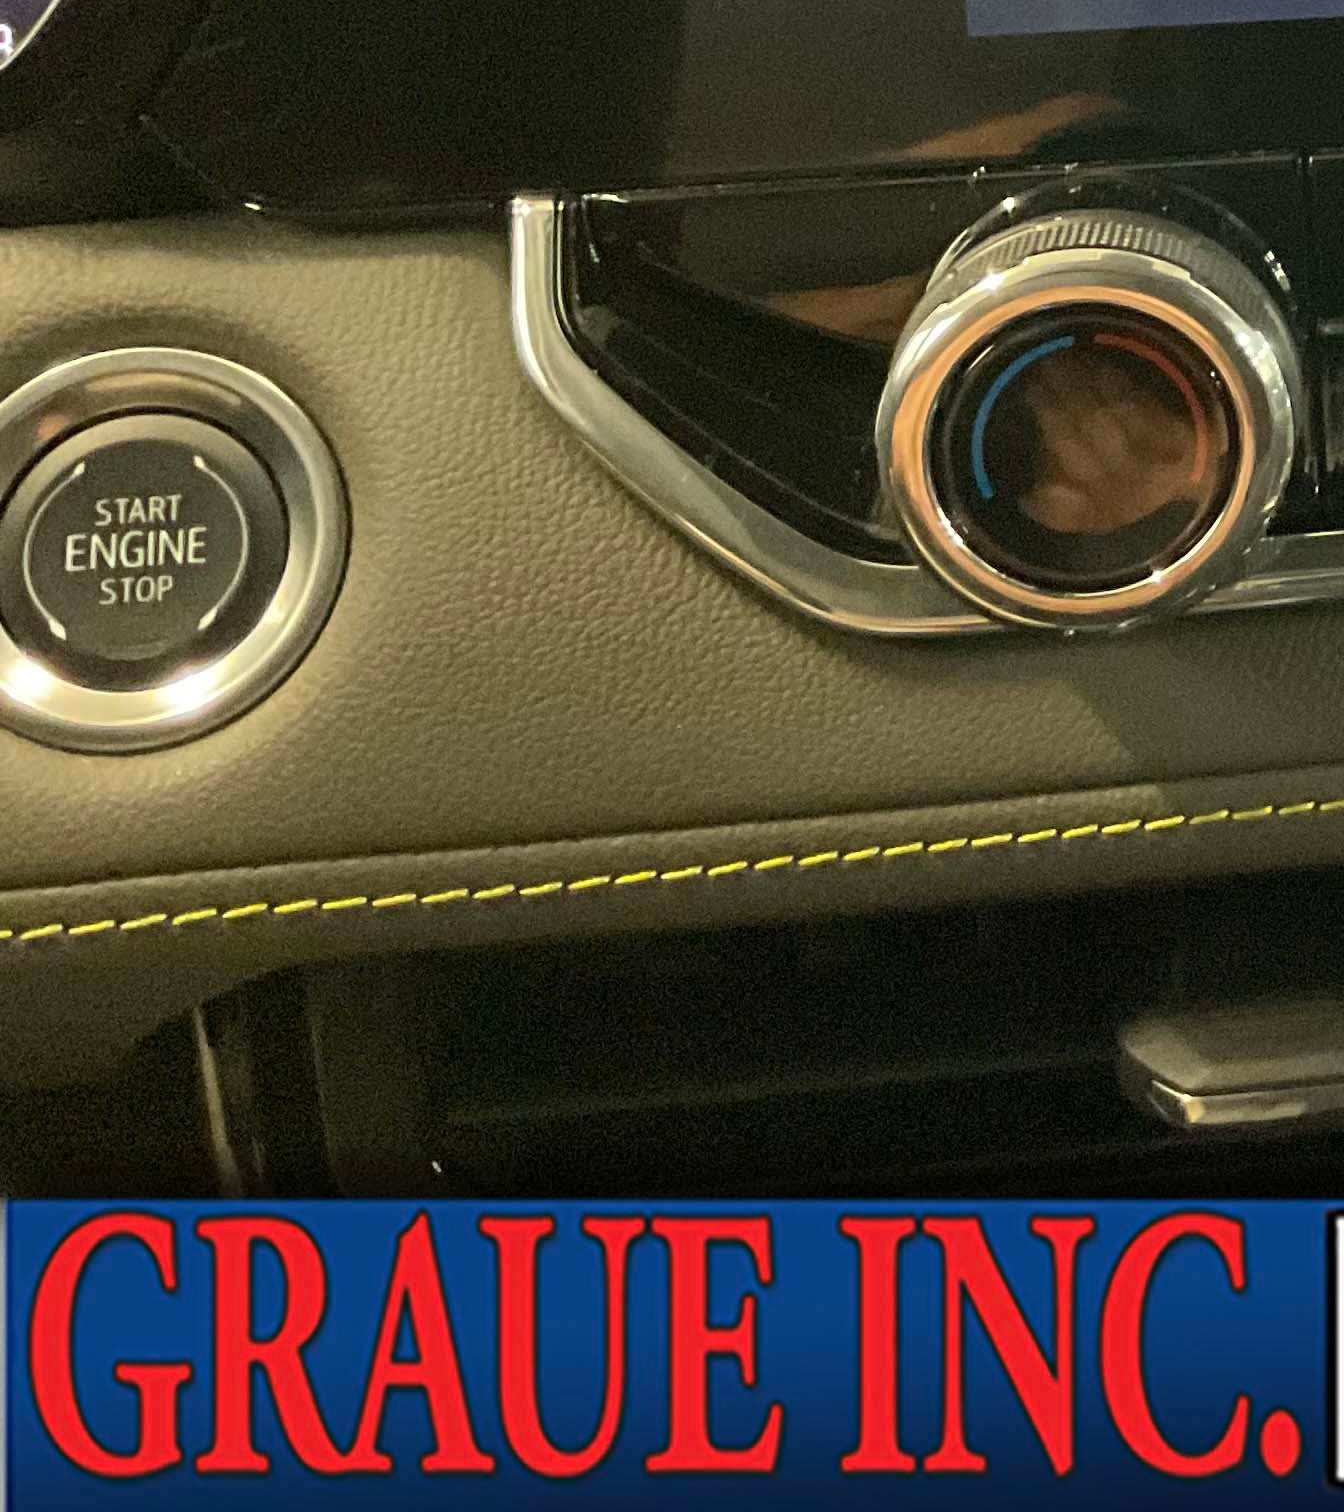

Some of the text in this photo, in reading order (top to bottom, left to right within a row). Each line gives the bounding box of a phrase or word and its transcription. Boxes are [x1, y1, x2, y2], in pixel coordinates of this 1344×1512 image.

[95, 494, 183, 526] START
[65, 526, 207, 572] ENGINE
[99, 575, 173, 605] STOP
